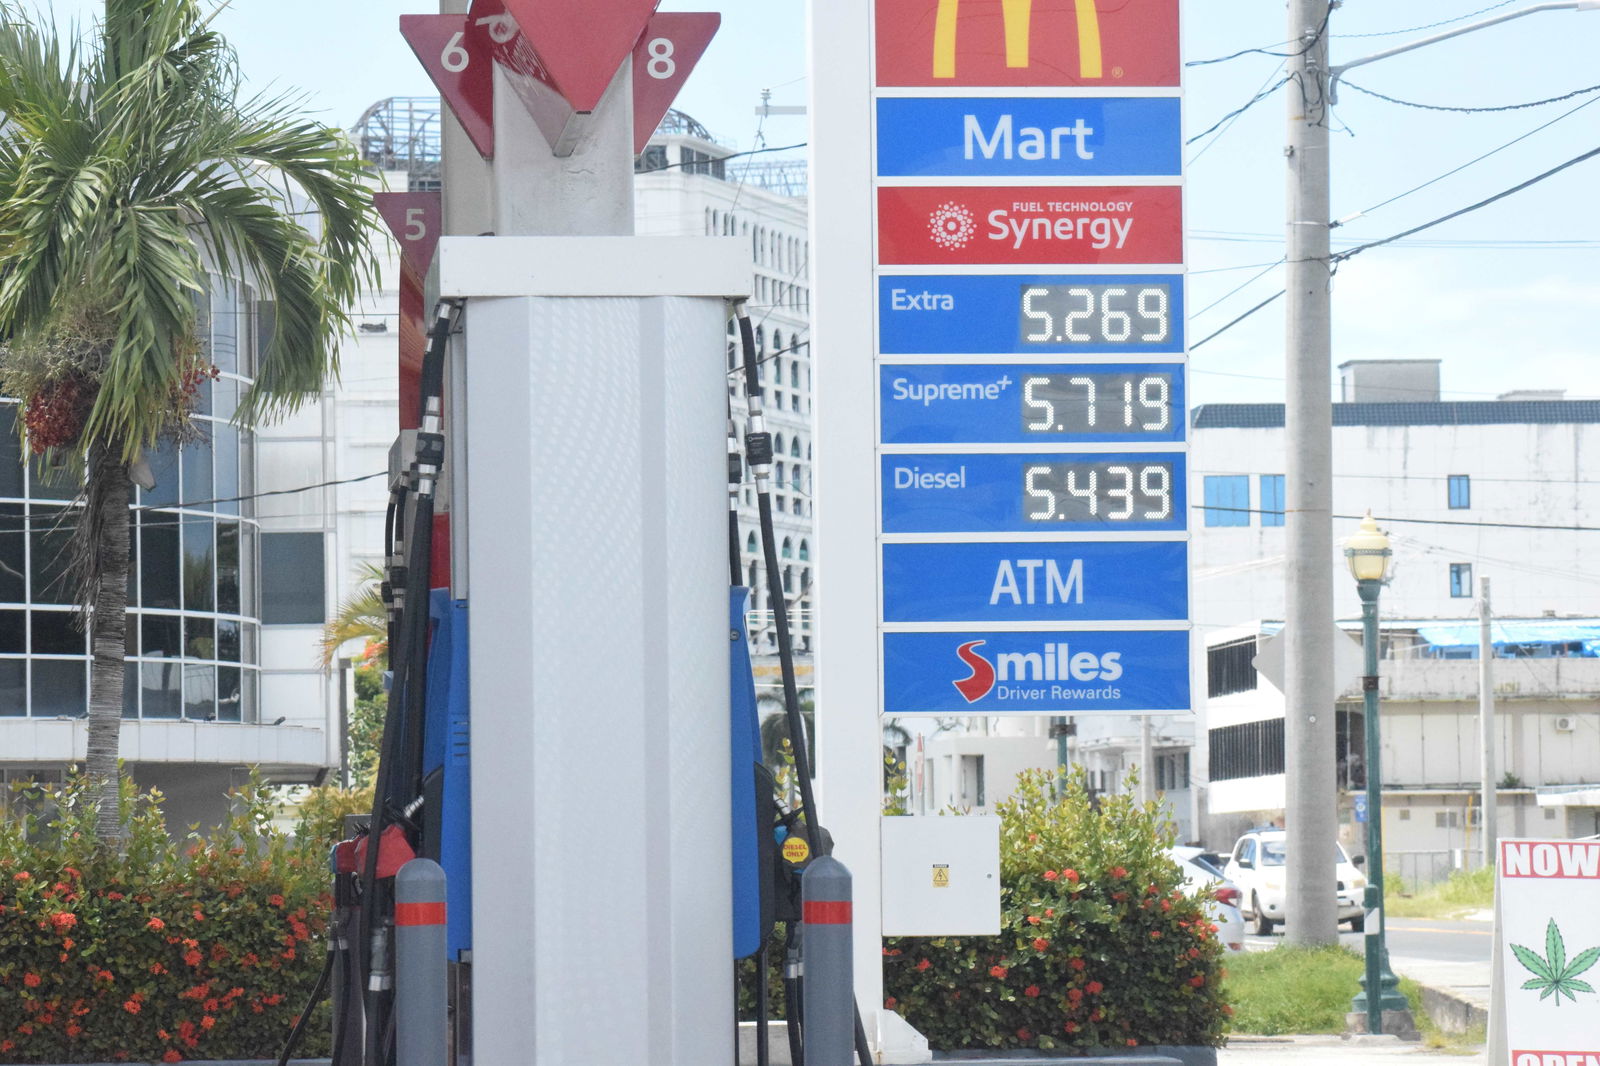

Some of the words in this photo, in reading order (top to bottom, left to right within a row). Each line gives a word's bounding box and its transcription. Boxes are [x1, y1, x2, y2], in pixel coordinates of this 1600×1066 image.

[440, 31, 470, 73] 6
[646, 37, 676, 80] 8
[963, 114, 1094, 160] Mart
[405, 208, 427, 241] 5
[1012, 201, 1044, 213] FUEL
[1047, 201, 1134, 213] TECHNOLOGY
[987, 209, 1134, 249] Synergy
[891, 288, 954, 311] Extra
[1022, 287, 1168, 342] 5.269
[1024, 376, 1169, 431] 5.719
[893, 465, 966, 489] Diesel
[1025, 465, 1171, 520] 5.439
[988, 558, 1084, 605] ATM
[951, 639, 1124, 704] Smiles
[997, 685, 1046, 700] Driver
[1051, 684, 1122, 700] Rewards
[1505, 843, 1600, 877] NOW
